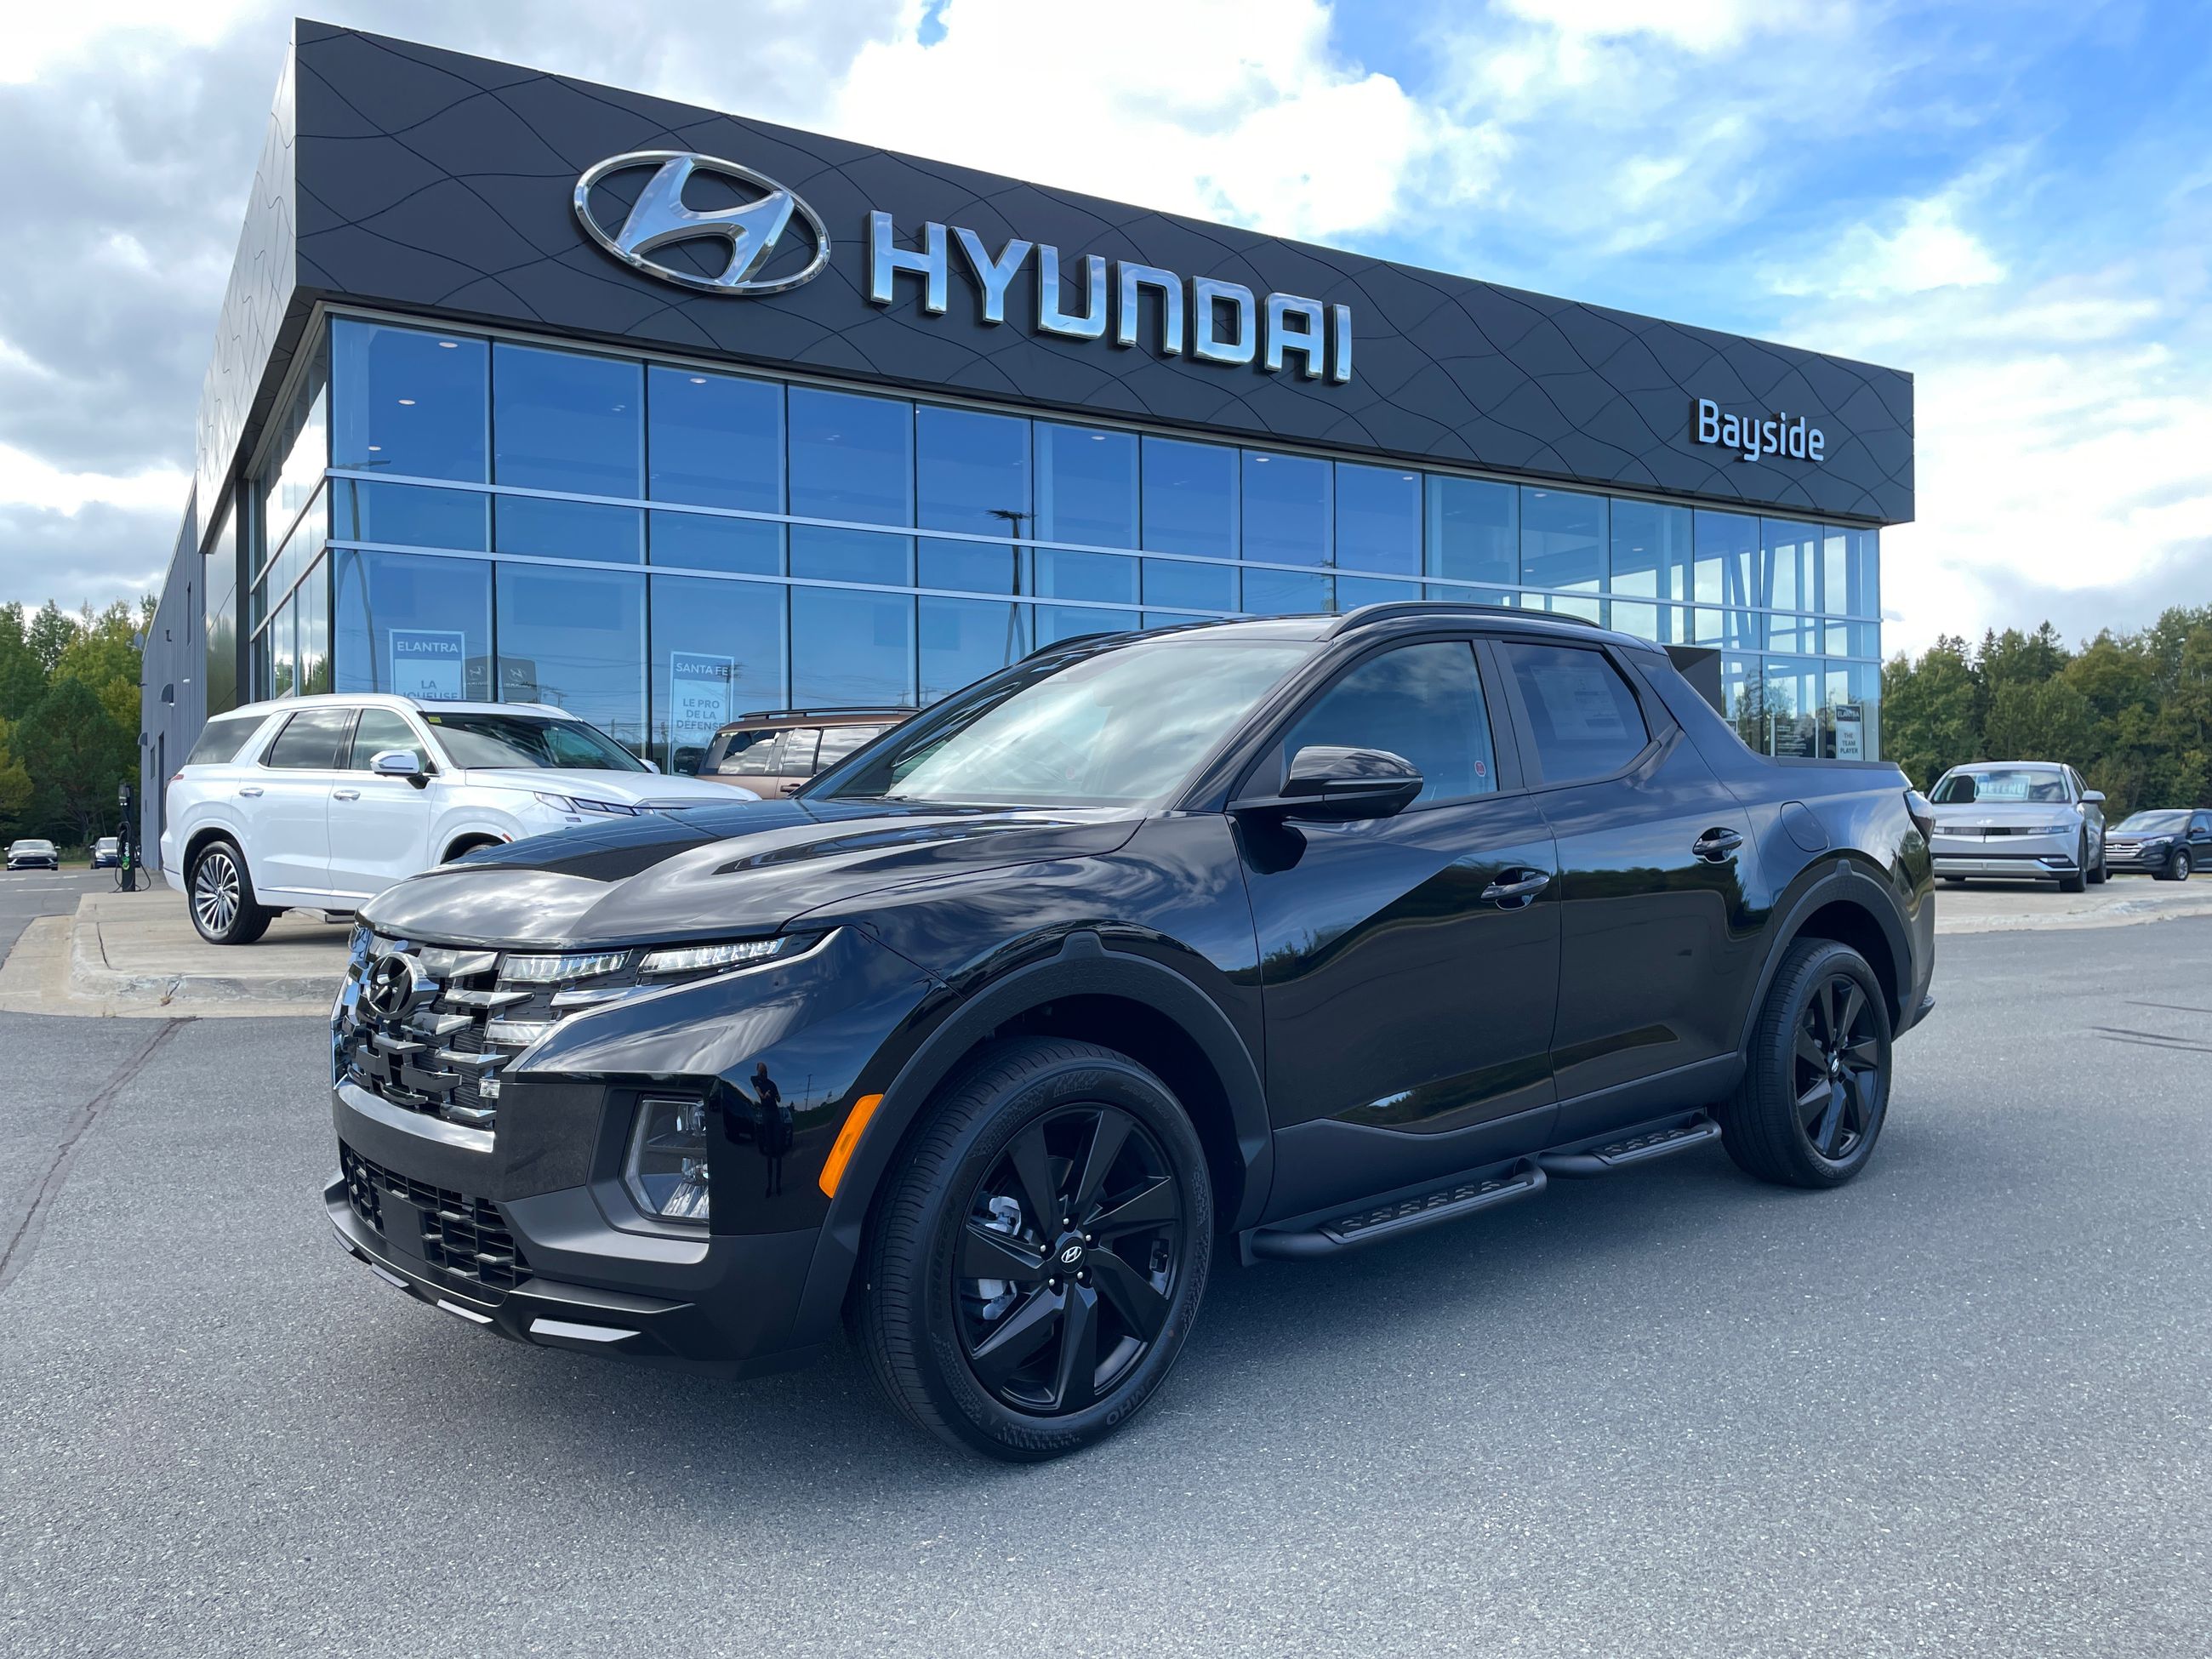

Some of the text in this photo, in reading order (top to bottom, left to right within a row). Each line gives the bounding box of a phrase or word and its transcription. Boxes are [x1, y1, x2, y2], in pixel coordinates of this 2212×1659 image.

[869, 209, 1352, 384] HYUNDAI
[1698, 398, 1825, 462] Bayside
[396, 641, 459, 653] ELANTRA
[676, 663, 729, 676] SANTA FE
[421, 680, 437, 689] LA
[683, 698, 720, 709] LE PRO
[686, 710, 716, 720] DE LA
